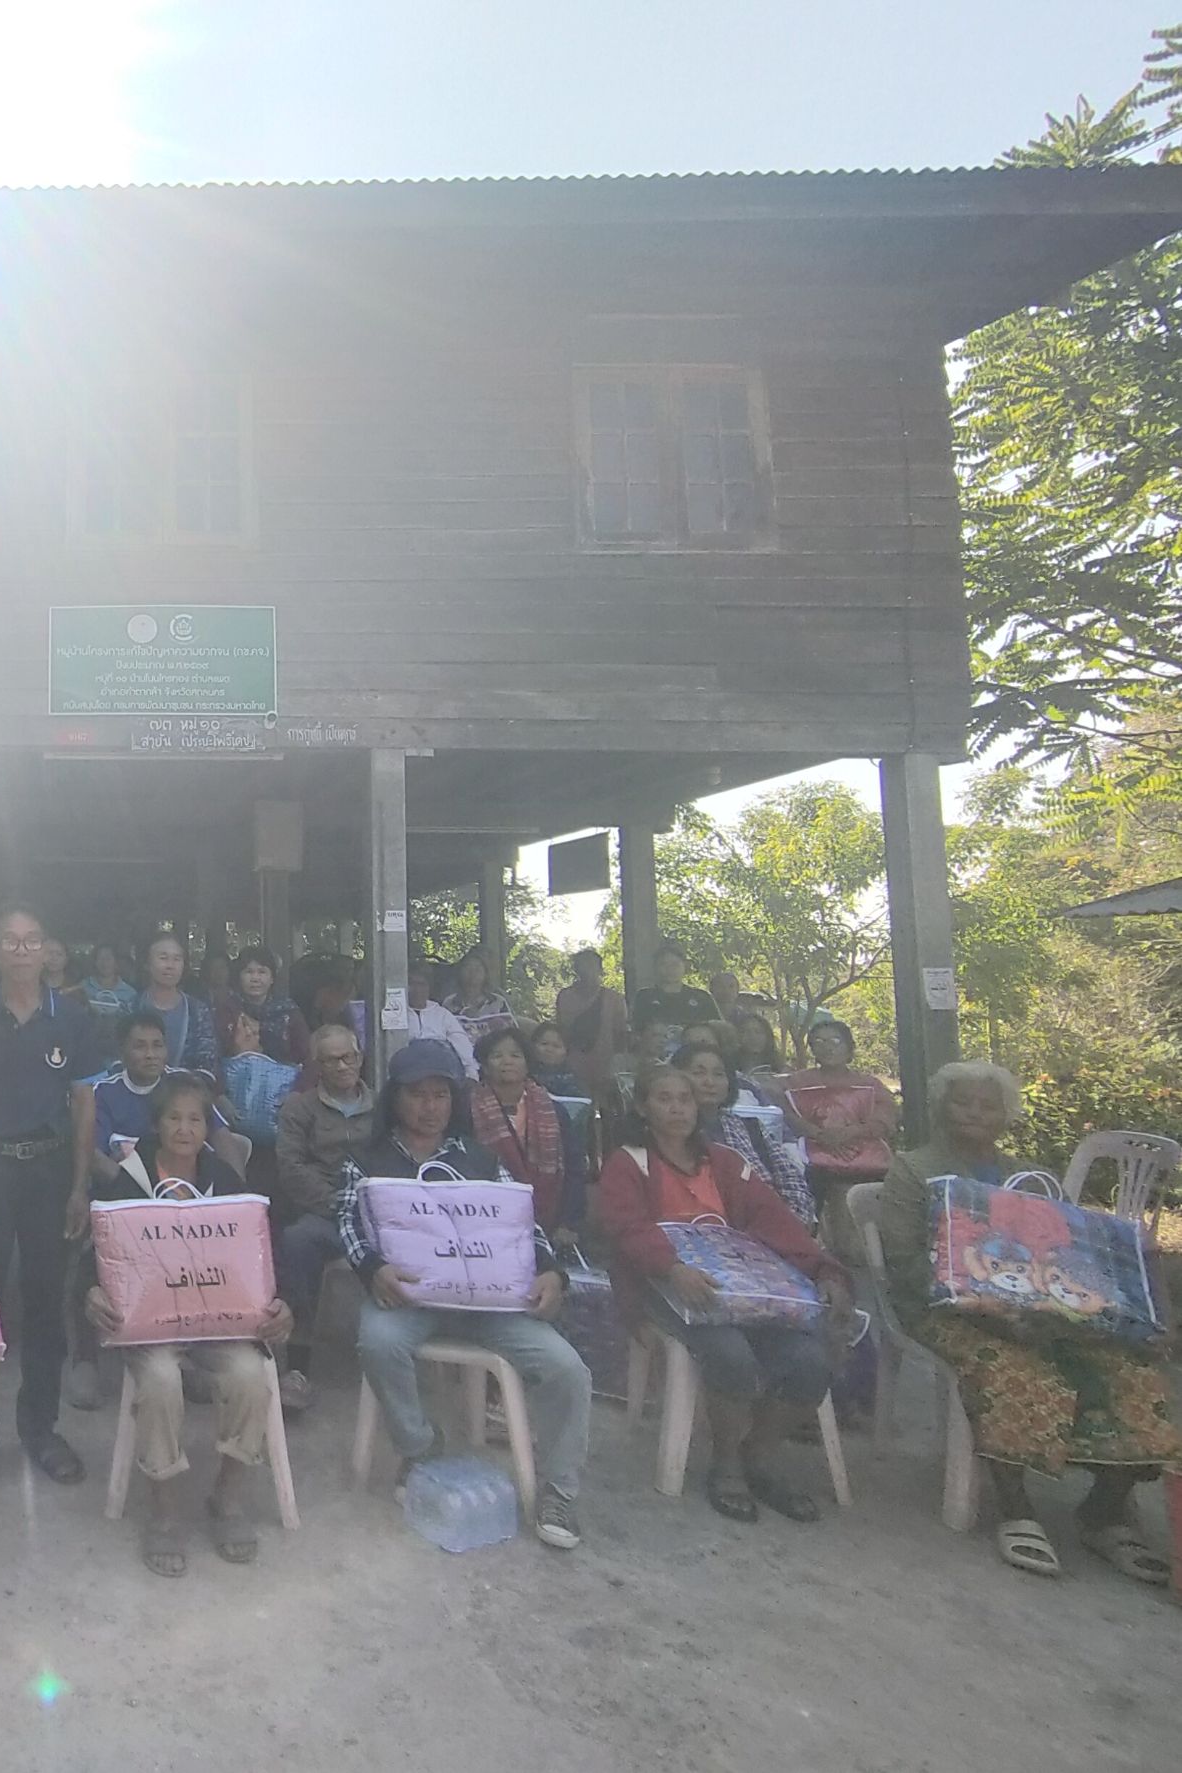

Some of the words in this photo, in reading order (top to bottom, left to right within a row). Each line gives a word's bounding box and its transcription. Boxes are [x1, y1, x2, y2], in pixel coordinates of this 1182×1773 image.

[408, 1202, 435, 1216] AL
[437, 1203, 502, 1218] NADAF
[140, 1224, 167, 1241] AL
[171, 1222, 240, 1239] NADAF
[434, 1239, 494, 1260] النداف
[164, 1265, 227, 1289] النداف
